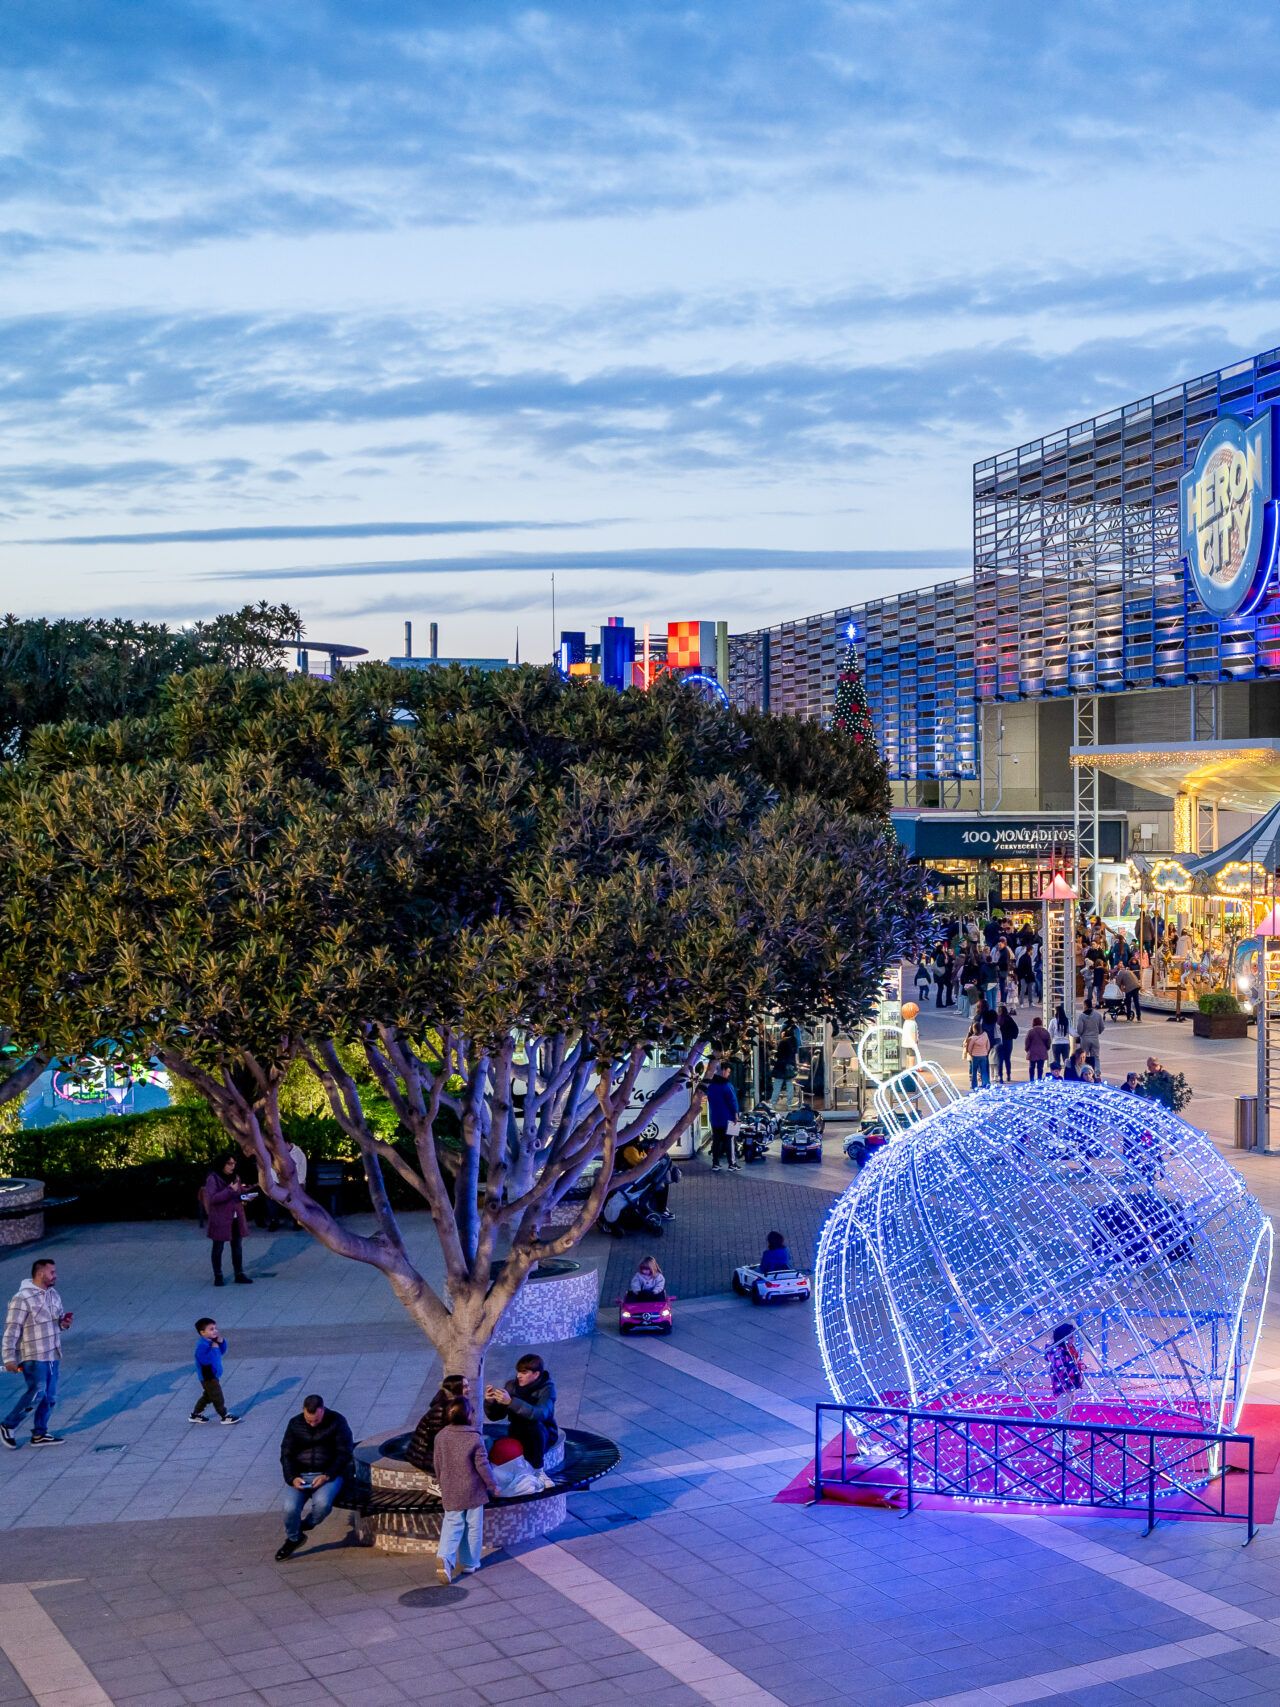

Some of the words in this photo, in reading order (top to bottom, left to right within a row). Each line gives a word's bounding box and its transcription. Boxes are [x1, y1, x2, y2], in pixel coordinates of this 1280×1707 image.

[1187, 433, 1263, 535] HERON
[1197, 491, 1252, 576] CITY
[962, 831, 991, 844] 100
[992, 828, 1076, 843] MONTADITOS
